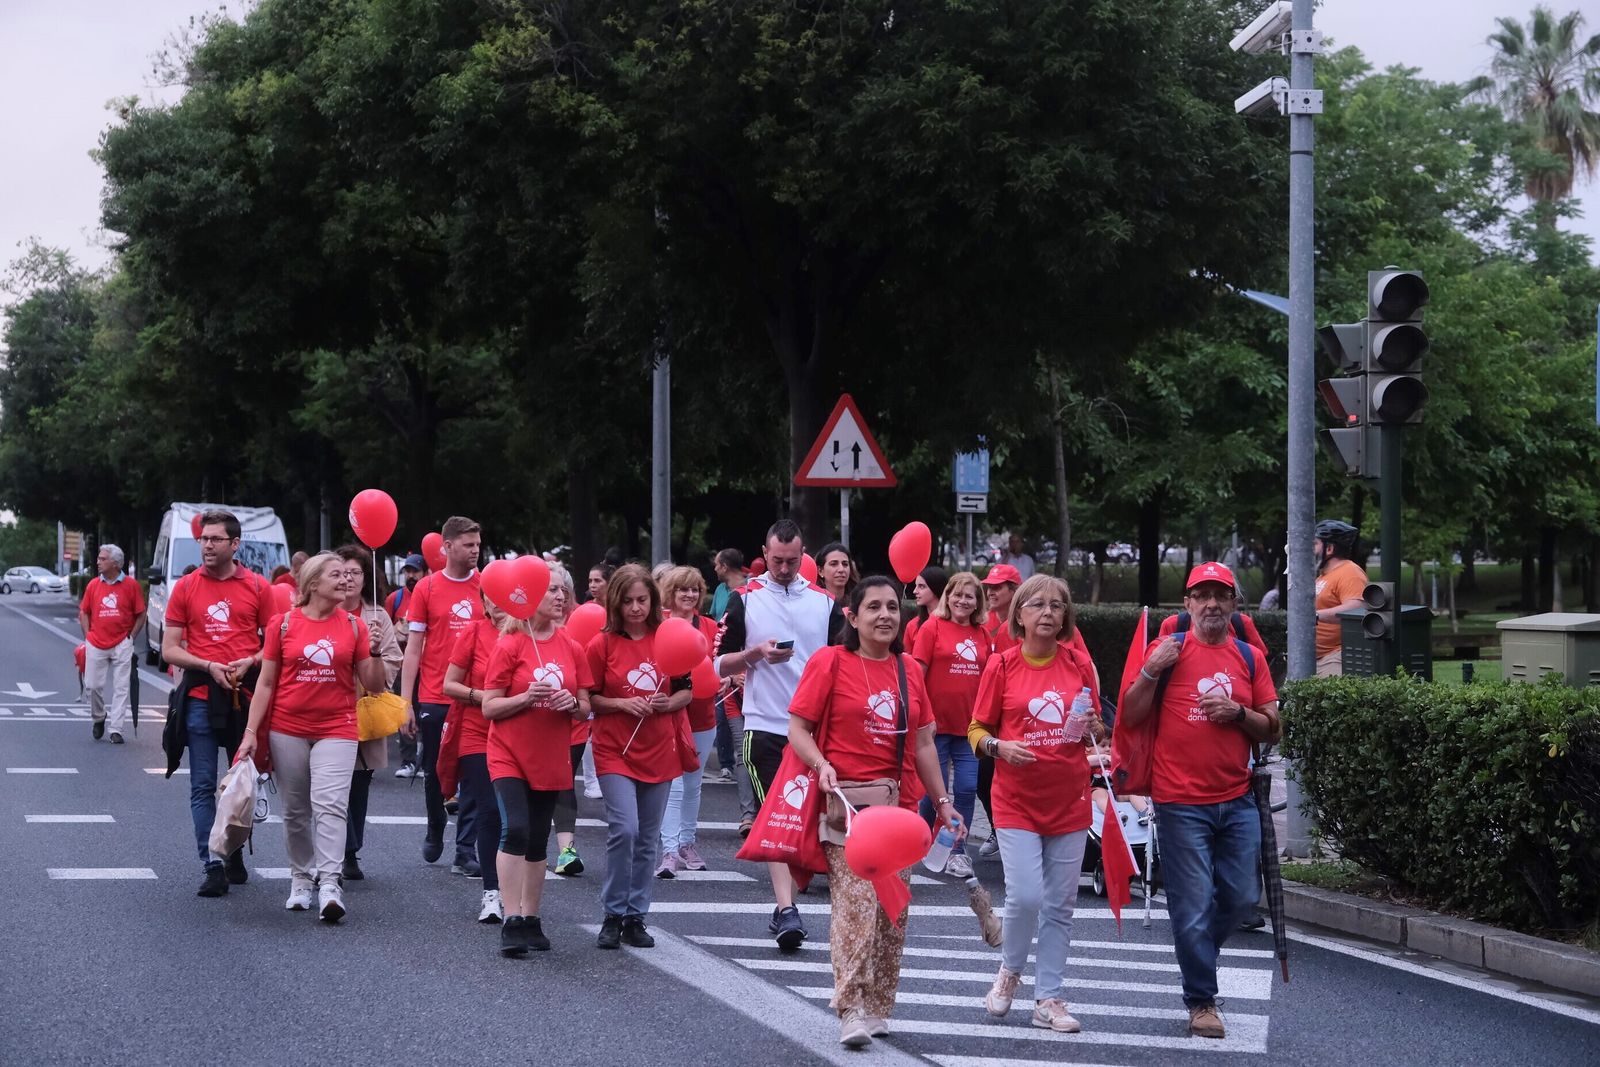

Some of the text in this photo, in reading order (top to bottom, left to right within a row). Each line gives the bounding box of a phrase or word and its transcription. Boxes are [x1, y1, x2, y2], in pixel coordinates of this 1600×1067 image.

[1187, 714, 1208, 722] dona
[1024, 728, 1064, 740] regala VID
